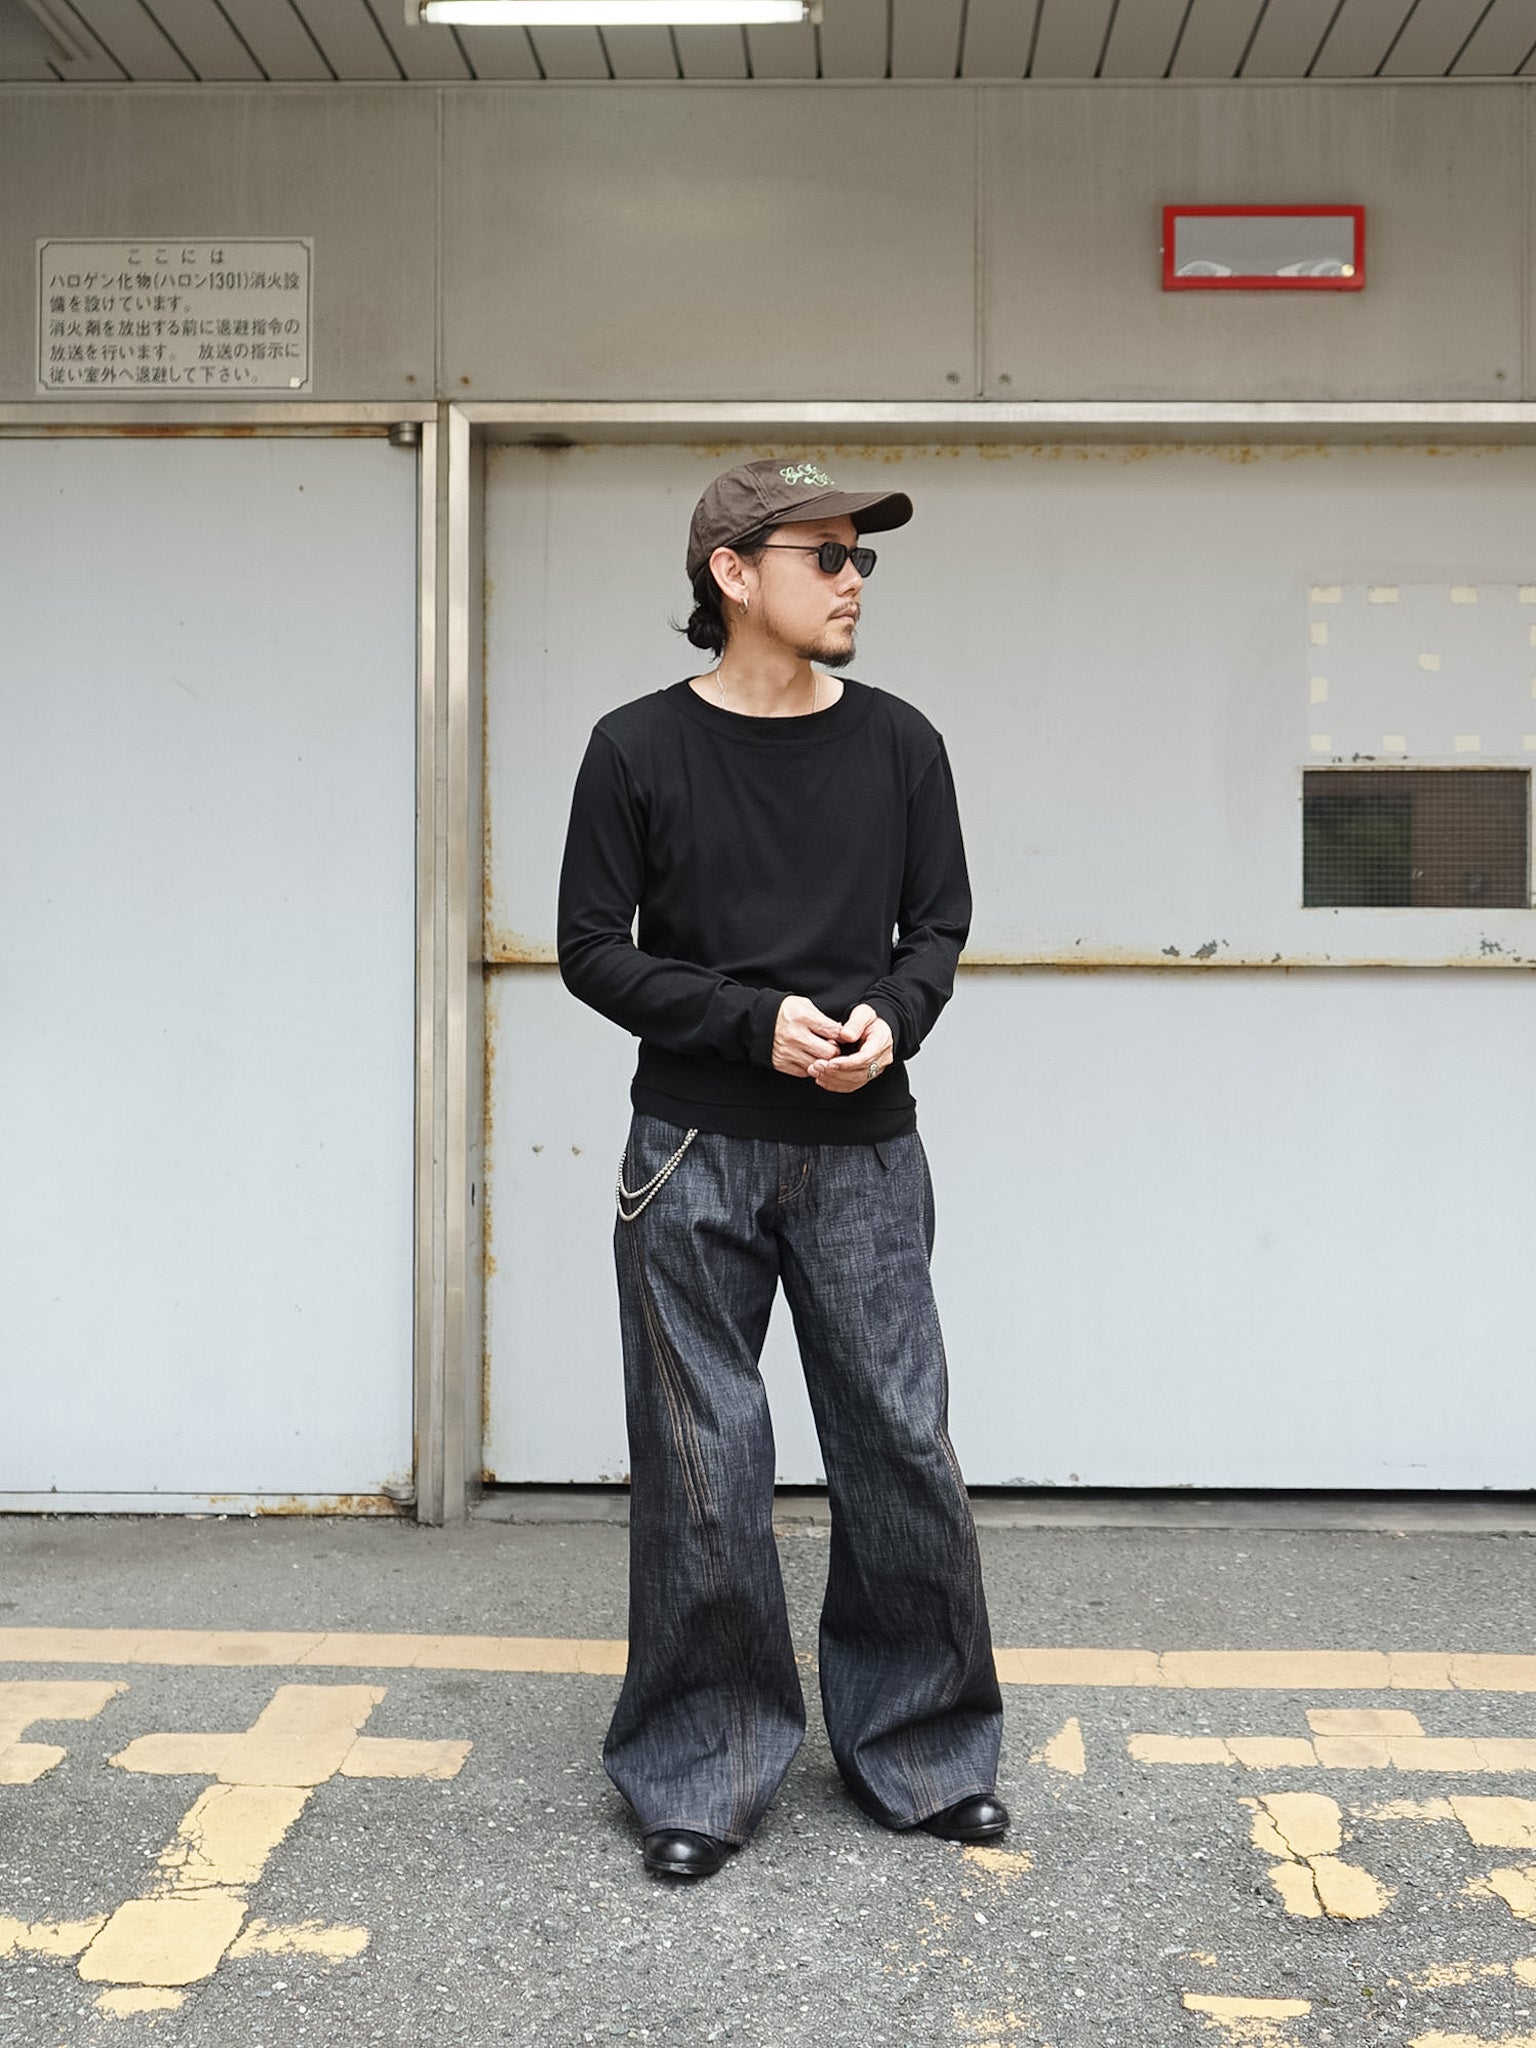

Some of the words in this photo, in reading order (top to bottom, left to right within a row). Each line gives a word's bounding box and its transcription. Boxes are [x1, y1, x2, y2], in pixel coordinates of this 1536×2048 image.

[127, 249, 224, 265] ここには
[50, 294, 192, 313] 備を設けています。
[50, 318, 300, 337] 消火剤を放出する前に退避指令の
[50, 365, 259, 384] 従い室外へ退避して下さい。
